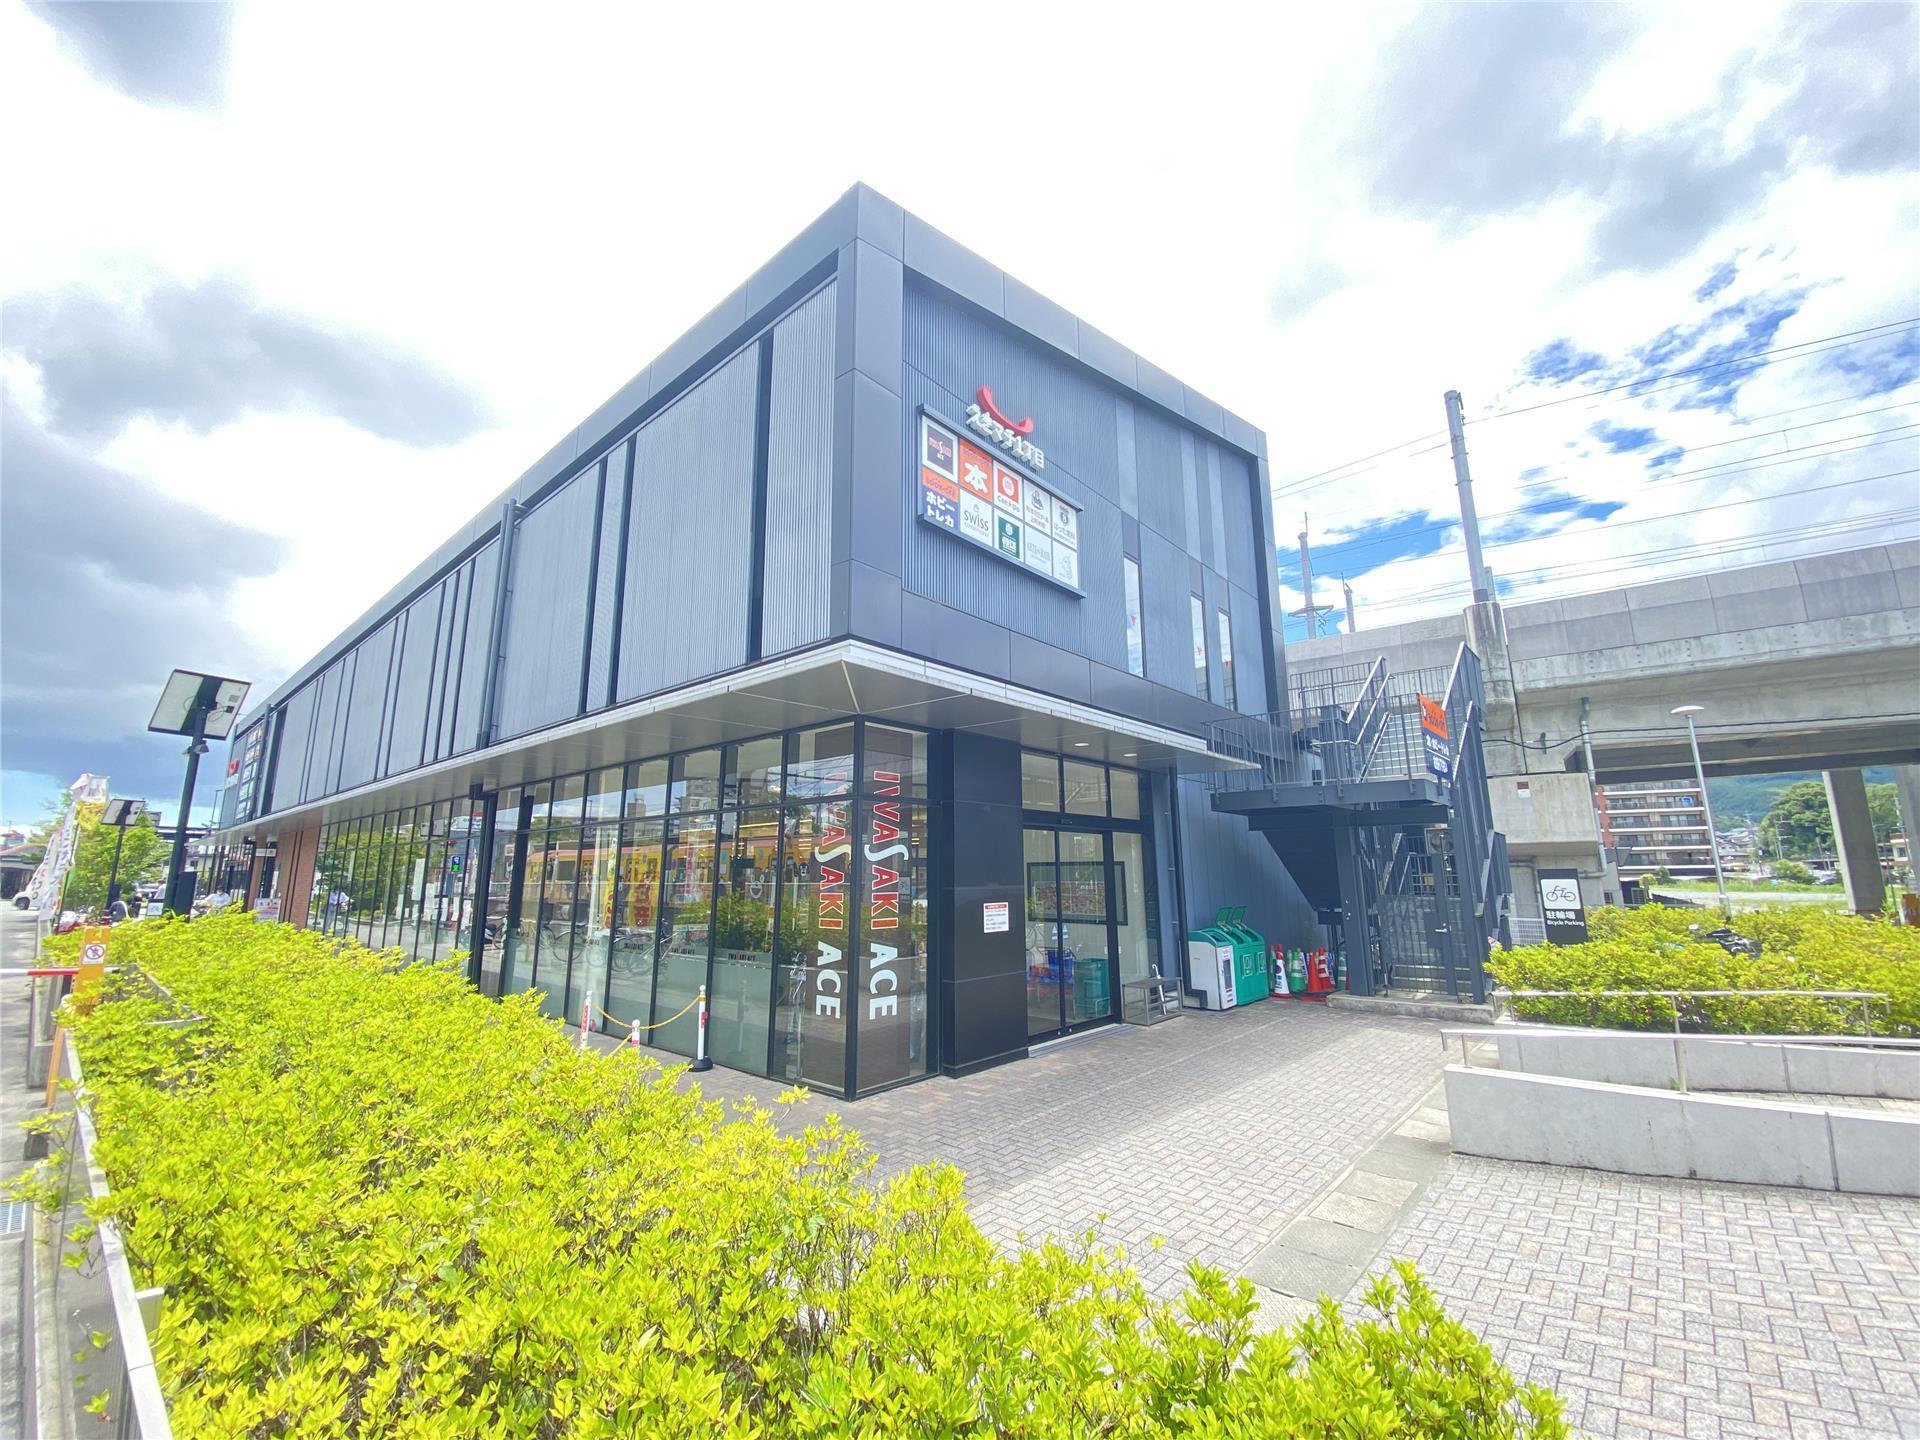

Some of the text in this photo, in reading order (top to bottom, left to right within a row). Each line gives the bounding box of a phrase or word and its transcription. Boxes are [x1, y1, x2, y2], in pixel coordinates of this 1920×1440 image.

[963, 461, 988, 494] 本
[926, 490, 956, 512] ホビー
[926, 504, 955, 528] トレカ
[864, 770, 909, 1020] IWASAKI ACE
[1546, 910, 1576, 920] 駐輪場
[815, 940, 842, 1020] ACE
